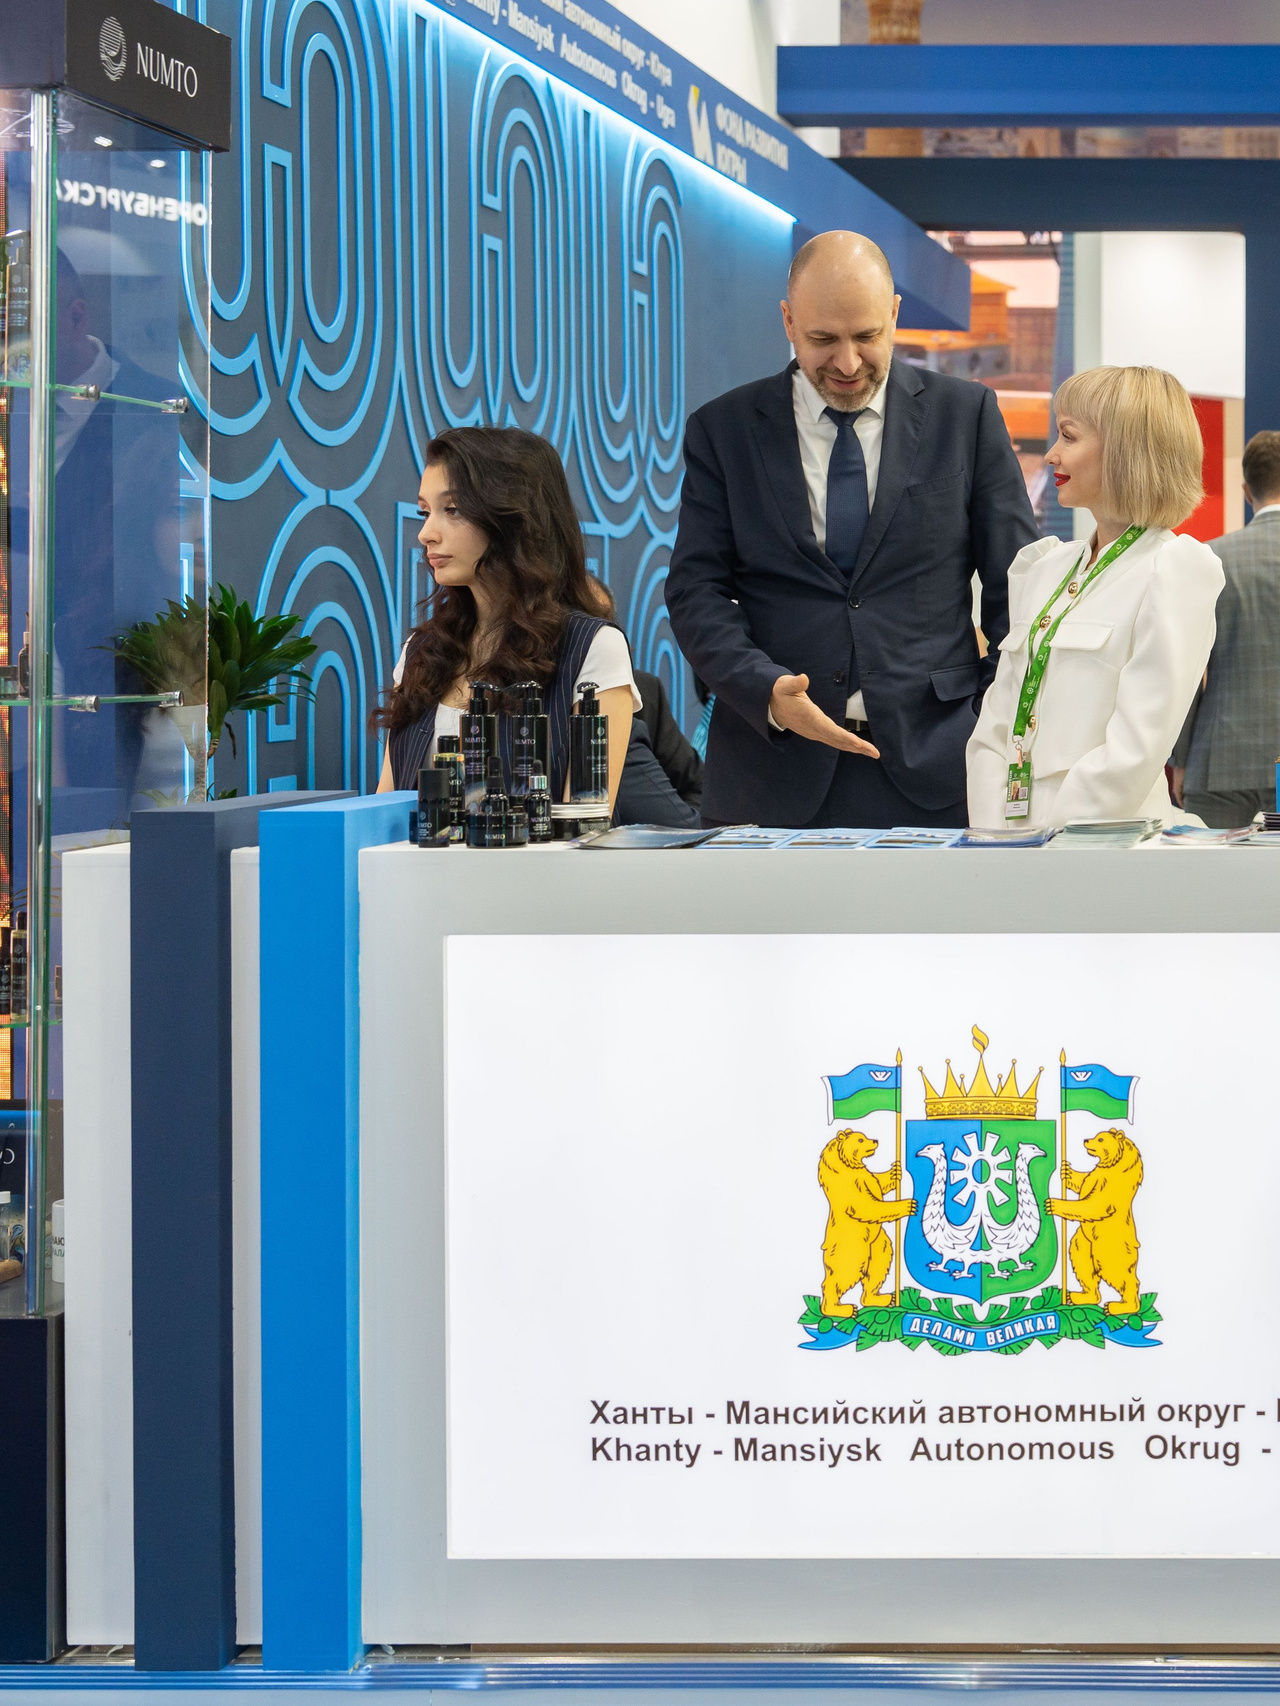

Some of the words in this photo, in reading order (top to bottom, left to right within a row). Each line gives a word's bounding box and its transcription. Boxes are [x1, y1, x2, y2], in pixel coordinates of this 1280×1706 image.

[136, 42, 198, 98] NUMTO
[560, 33, 617, 89] Autonomous
[621, 71, 647, 114] Okrug
[656, 94, 676, 129] Ugra
[909, 1317, 976, 1346] ДЕЛАМИ
[985, 1315, 1056, 1346] ВЕЛИКАЯ
[590, 1400, 693, 1425] Ханты
[726, 1399, 926, 1425] Мансийский
[938, 1397, 1145, 1424] автономный
[1157, 1403, 1246, 1429] округ
[591, 1437, 702, 1468] Khanty
[734, 1437, 882, 1468] Mansiysk
[909, 1436, 1114, 1462] Autonomous
[1145, 1434, 1240, 1467] Okrug
